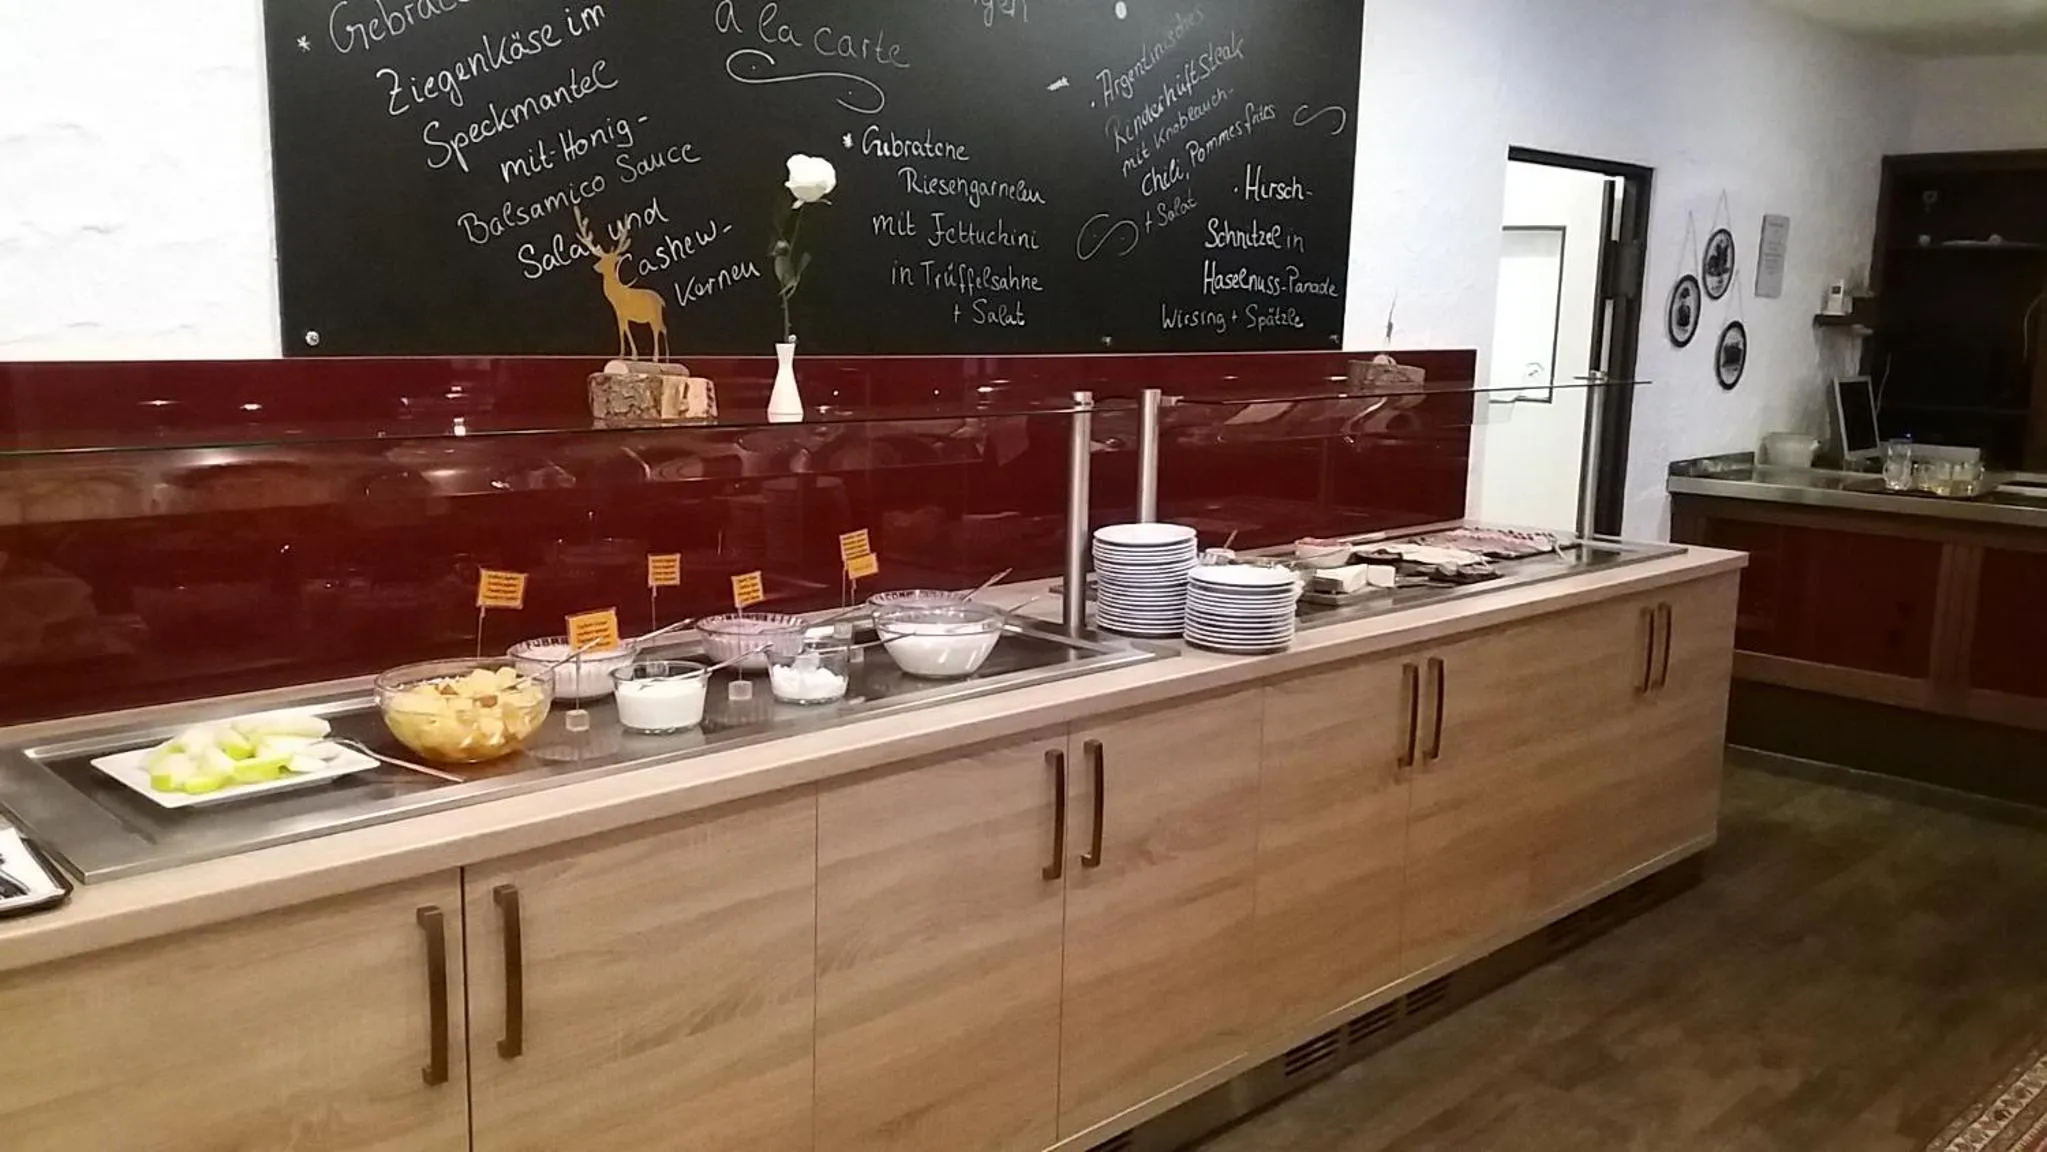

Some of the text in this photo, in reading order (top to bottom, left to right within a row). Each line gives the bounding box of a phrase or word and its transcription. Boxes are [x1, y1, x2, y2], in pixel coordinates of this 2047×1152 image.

[565, 4, 605, 36] im
[758, 2, 803, 46] la
[423, 60, 619, 172] Speckmantel
[1122, 141, 1151, 178] mit
[457, 143, 702, 244] Balsamico Sauce
[898, 166, 1047, 209] Riesengarnelen
[872, 210, 917, 236] mit
[1156, 188, 1199, 227] Salat
[517, 197, 670, 280] Sala und
[616, 219, 734, 288] Cashew-
[1204, 217, 1305, 253] Schnitzel in
[891, 259, 1044, 297] in Trüffelsahne
[972, 298, 1026, 326] Salat
[1162, 303, 1227, 333] Wirsing
[1245, 303, 1305, 332] Spätzle
